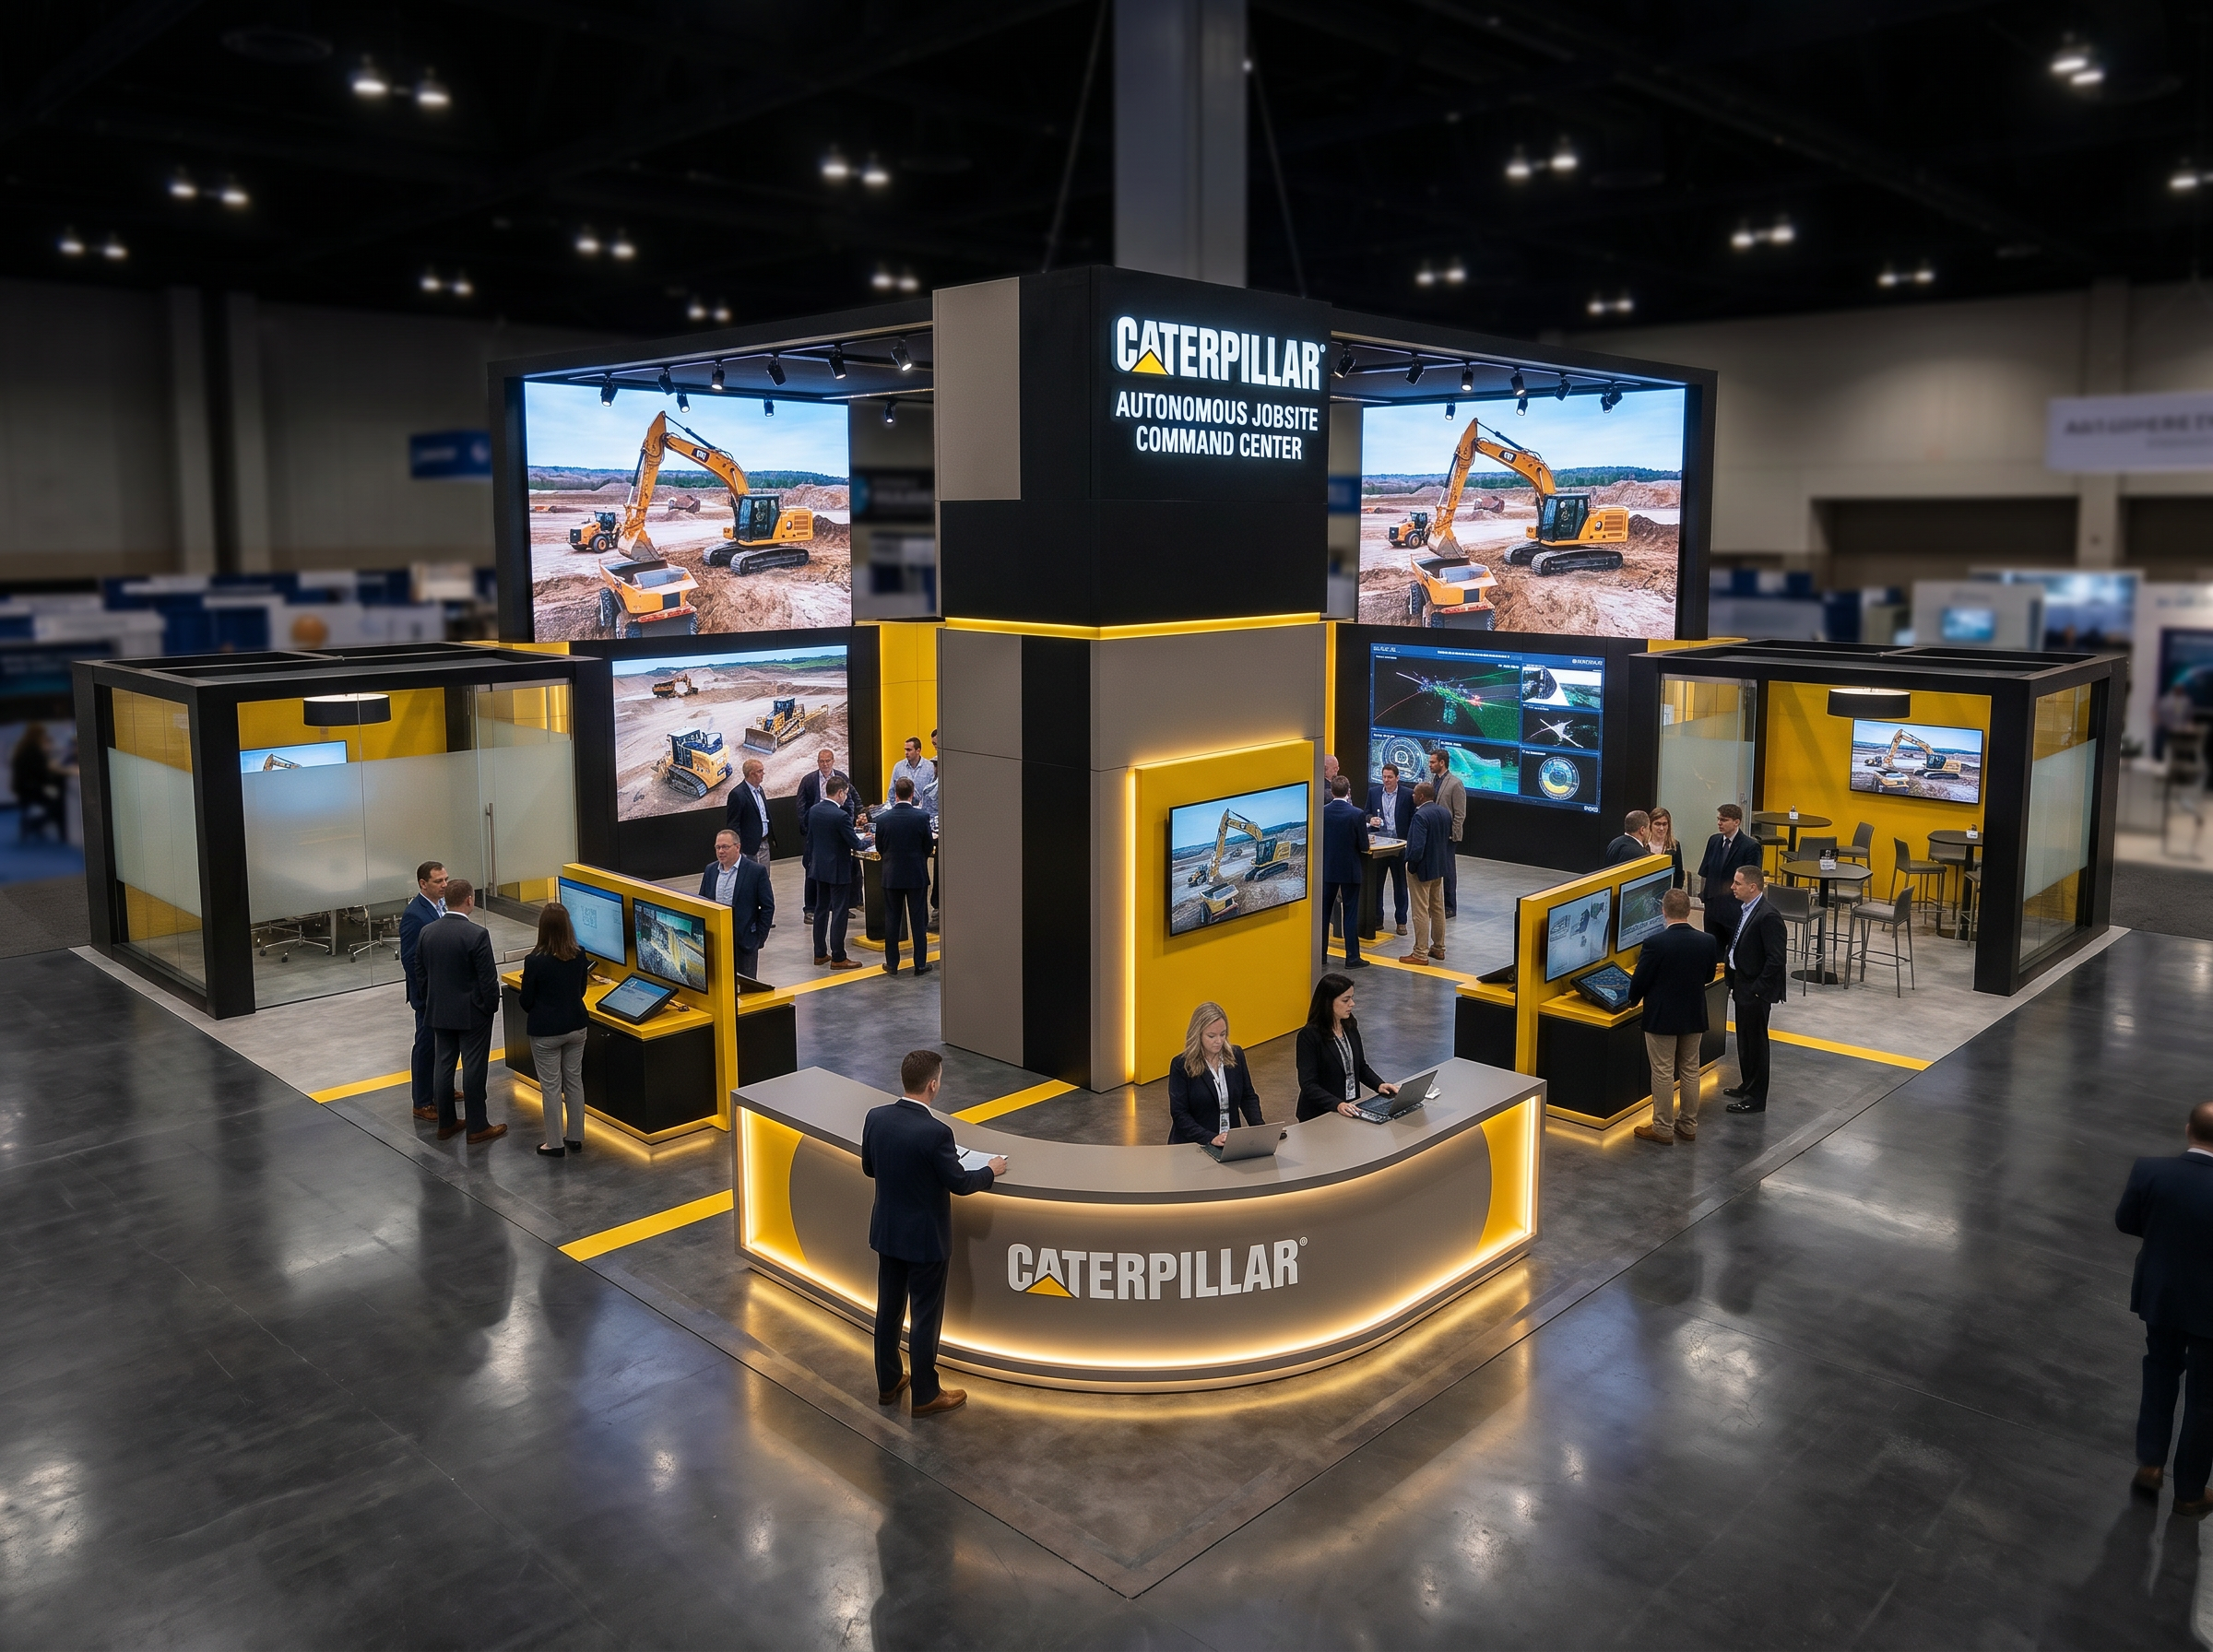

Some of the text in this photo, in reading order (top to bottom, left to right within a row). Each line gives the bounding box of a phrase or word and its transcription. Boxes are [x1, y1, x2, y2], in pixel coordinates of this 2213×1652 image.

[1116, 315, 1320, 391] CATERPILLAR
[1115, 391, 1319, 431] AUTONOMOUS JOBSITE
[1136, 425, 1302, 460] COMMAND CENTER
[1007, 1238, 1299, 1301] CATERPILLAR
